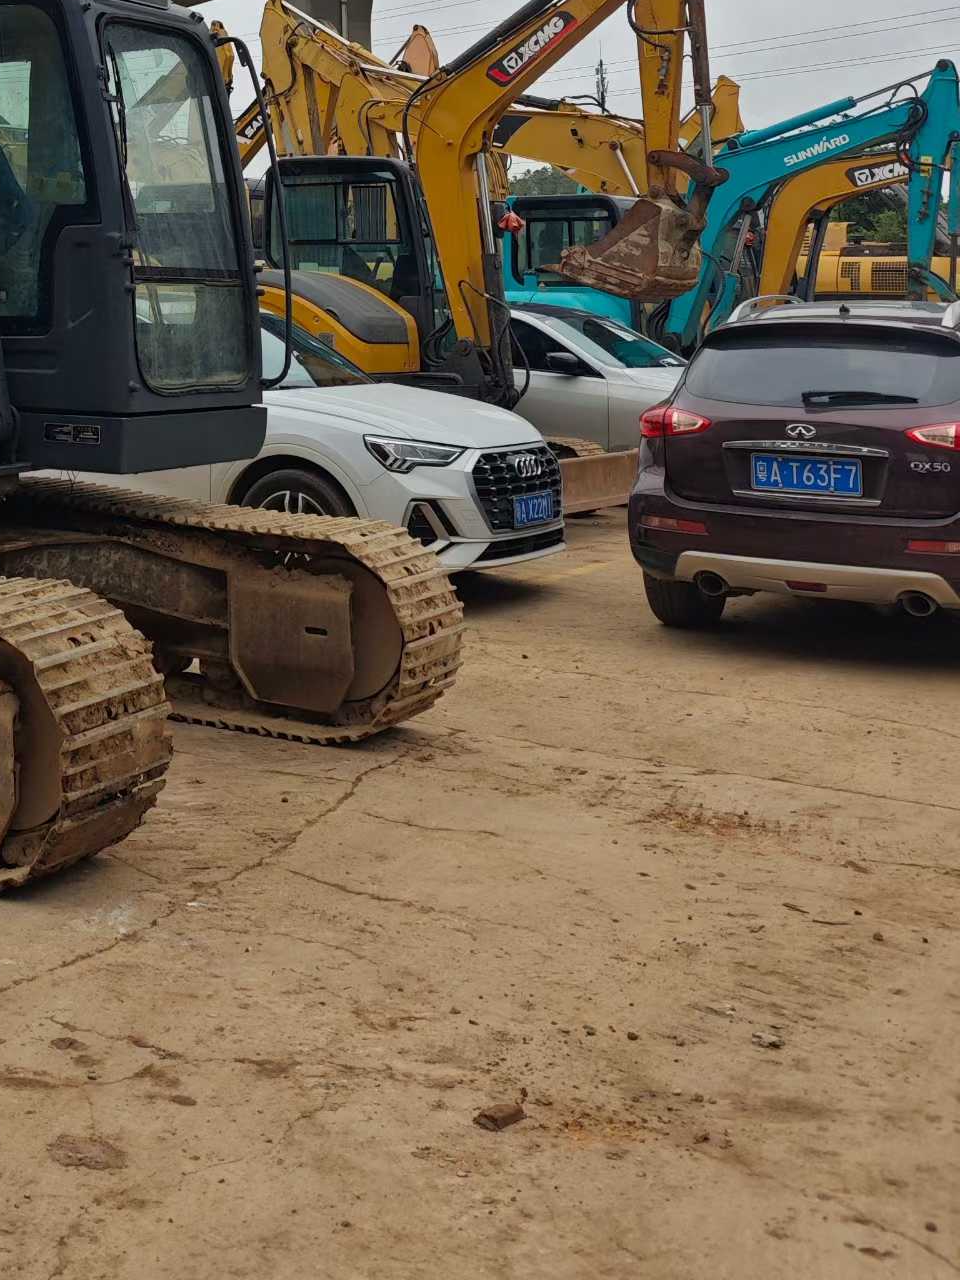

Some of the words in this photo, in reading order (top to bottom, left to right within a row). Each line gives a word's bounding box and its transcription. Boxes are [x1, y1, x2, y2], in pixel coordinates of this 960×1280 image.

[518, 16, 565, 63] XCMG
[783, 134, 849, 167] SUNWARD
[910, 461, 951, 473] QX50
